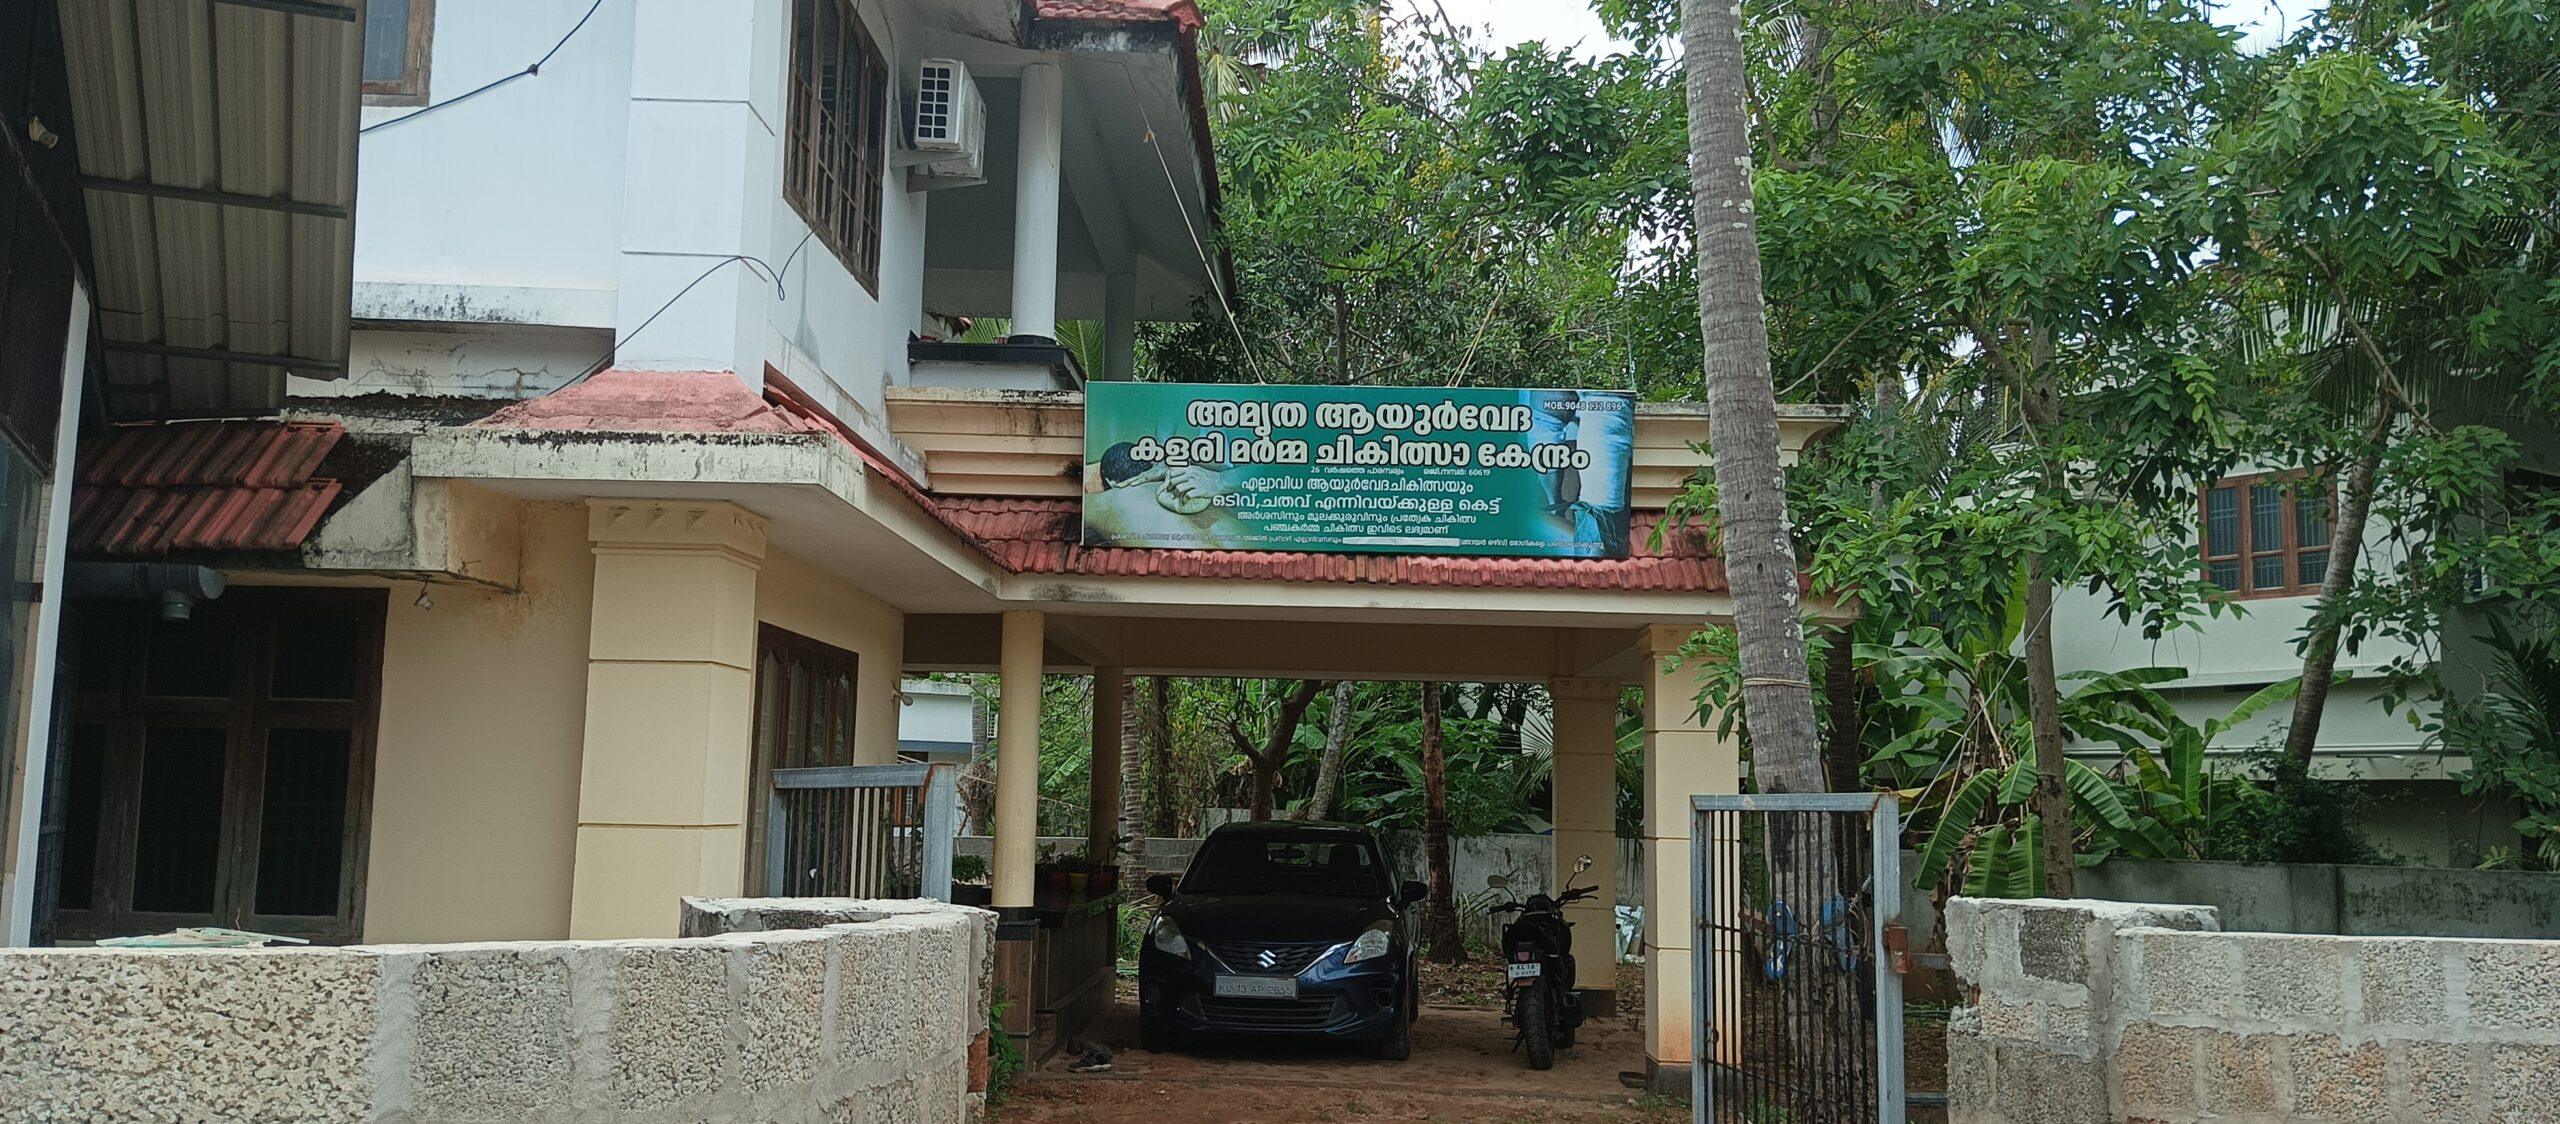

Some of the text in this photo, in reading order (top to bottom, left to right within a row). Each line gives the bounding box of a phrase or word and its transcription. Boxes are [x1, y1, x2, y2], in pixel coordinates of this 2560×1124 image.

[1606, 402, 1622, 411] 896
[1187, 399, 1533, 437] അമൃത ആയുർവേദ
[1129, 431, 1591, 472] കളരി മർമ്മ ചികിത്സാ കേന്ദ്രം
[1310, 466, 1320, 474] 26
[1468, 469, 1491, 477] 60619
[1241, 475, 1303, 492] എല്ലാവിധ
[1314, 494, 1454, 513] എന്നിവയ്ക്കുള്ള
[1458, 497, 1503, 514] കെട്ട്
[1367, 524, 1402, 535] ഇവിടെ
[1219, 984, 1232, 993] KL
[1238, 985, 1247, 993] 13
[1251, 985, 1264, 993] AP
